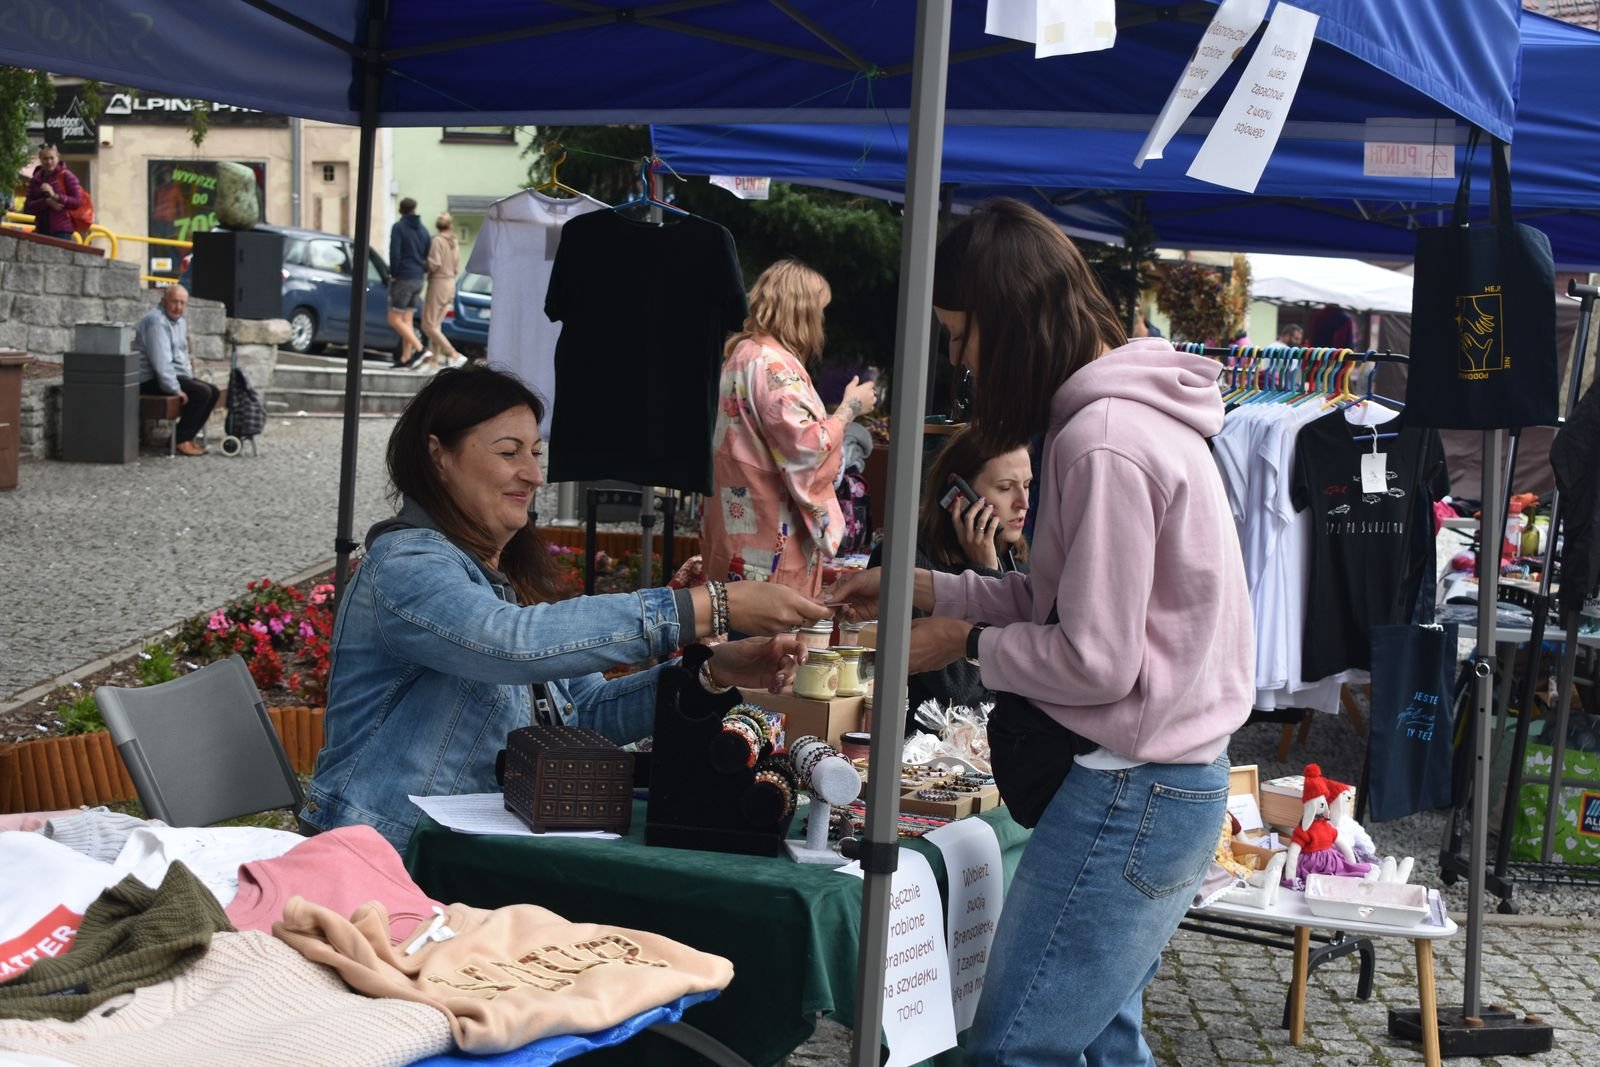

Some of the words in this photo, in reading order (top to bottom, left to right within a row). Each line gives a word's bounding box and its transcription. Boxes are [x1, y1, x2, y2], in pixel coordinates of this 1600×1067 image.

[191, 193, 208, 205] DO
[1584, 816, 1600, 826] AL
[962, 863, 990, 888] Wybierz
[966, 893, 986, 914] swoją
[890, 913, 925, 938] robione
[953, 919, 994, 949] Bransoletkę
[0, 925, 77, 976] ATTER
[896, 967, 938, 996] szydełku
[897, 1000, 924, 1023] TOHO
